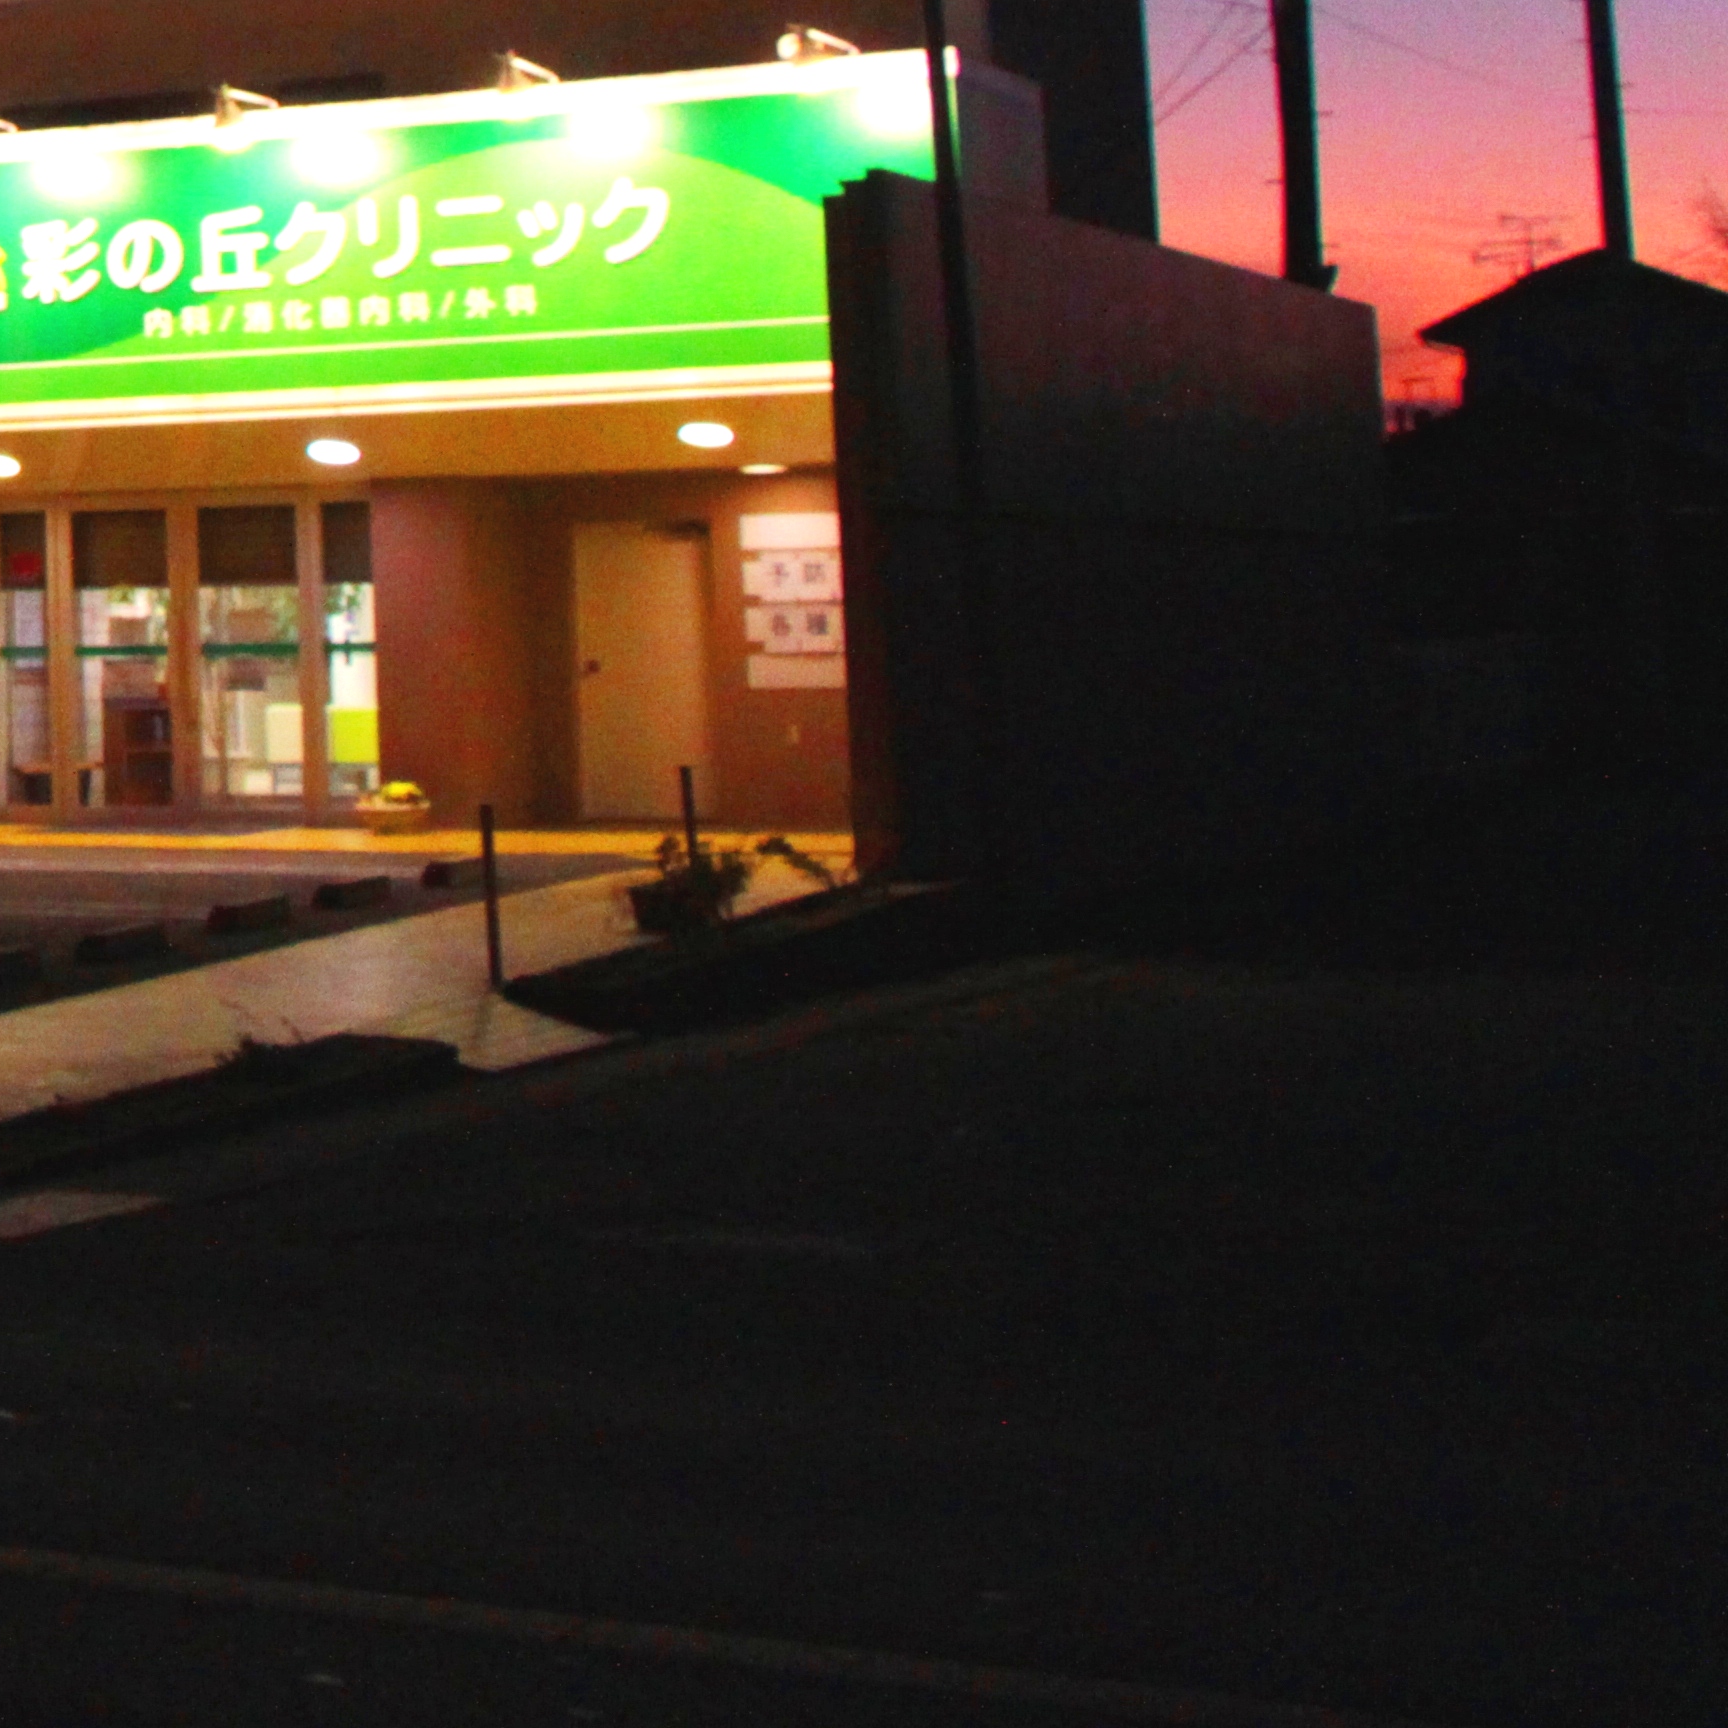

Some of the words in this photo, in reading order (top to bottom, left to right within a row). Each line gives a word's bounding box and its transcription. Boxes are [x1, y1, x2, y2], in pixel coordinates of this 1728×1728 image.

[21, 178, 671, 304] 彩の丘クリニック
